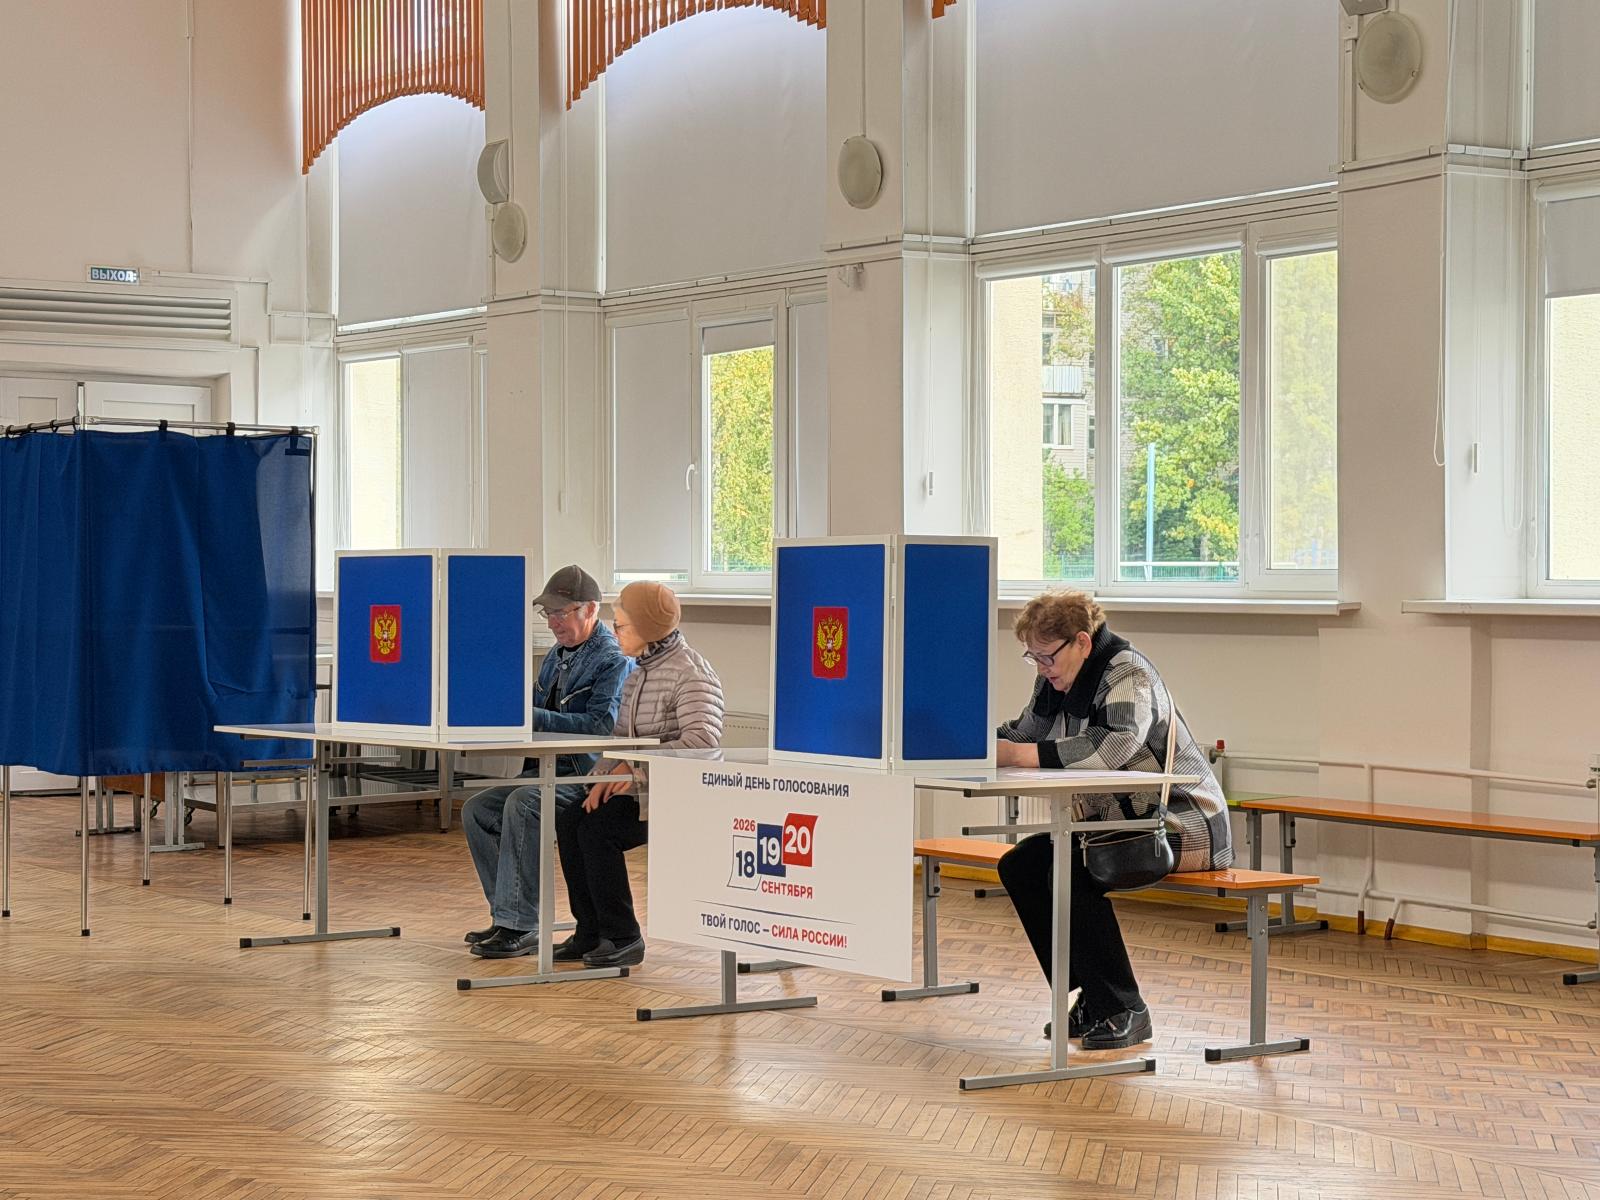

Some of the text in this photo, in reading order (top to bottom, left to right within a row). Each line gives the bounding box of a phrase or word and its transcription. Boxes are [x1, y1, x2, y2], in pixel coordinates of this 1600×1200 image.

[92, 269, 134, 282] ВЫХОД
[702, 772, 849, 797] ЕДИНЫЙ ДЕНЬ ГОЛОСОВАНИЯ
[733, 818, 756, 831] 2026
[736, 825, 810, 878] 18 19 20
[761, 881, 813, 899] СЕНТЯБРЯ
[701, 913, 726, 929] ТВОЙ
[729, 918, 760, 934] ГОЛОС
[771, 924, 799, 940] СИЛА
[801, 929, 847, 948] РОССИИ!
